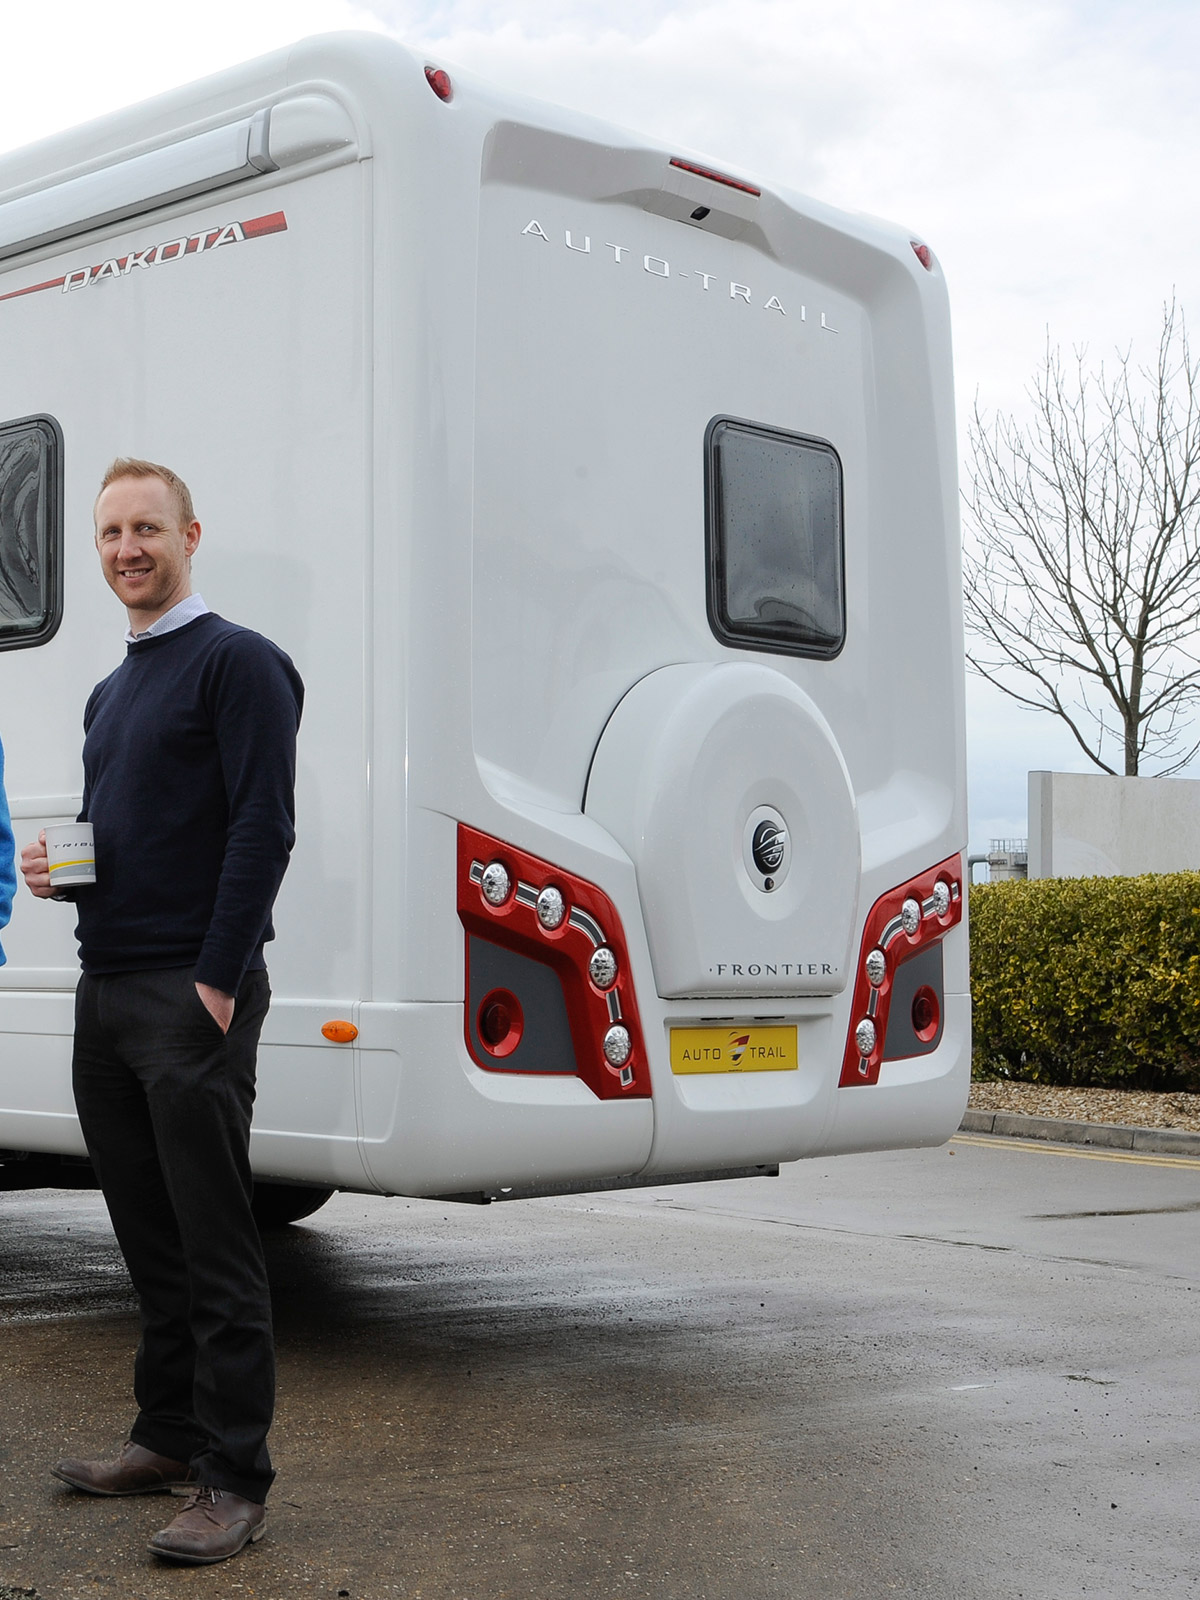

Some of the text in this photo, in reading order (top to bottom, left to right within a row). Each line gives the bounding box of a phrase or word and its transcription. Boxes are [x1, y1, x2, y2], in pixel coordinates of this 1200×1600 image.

[61, 221, 245, 293] DAKOTA
[716, 963, 833, 976] FRONTIER
[682, 1046, 786, 1060] AUTO TRAIL
